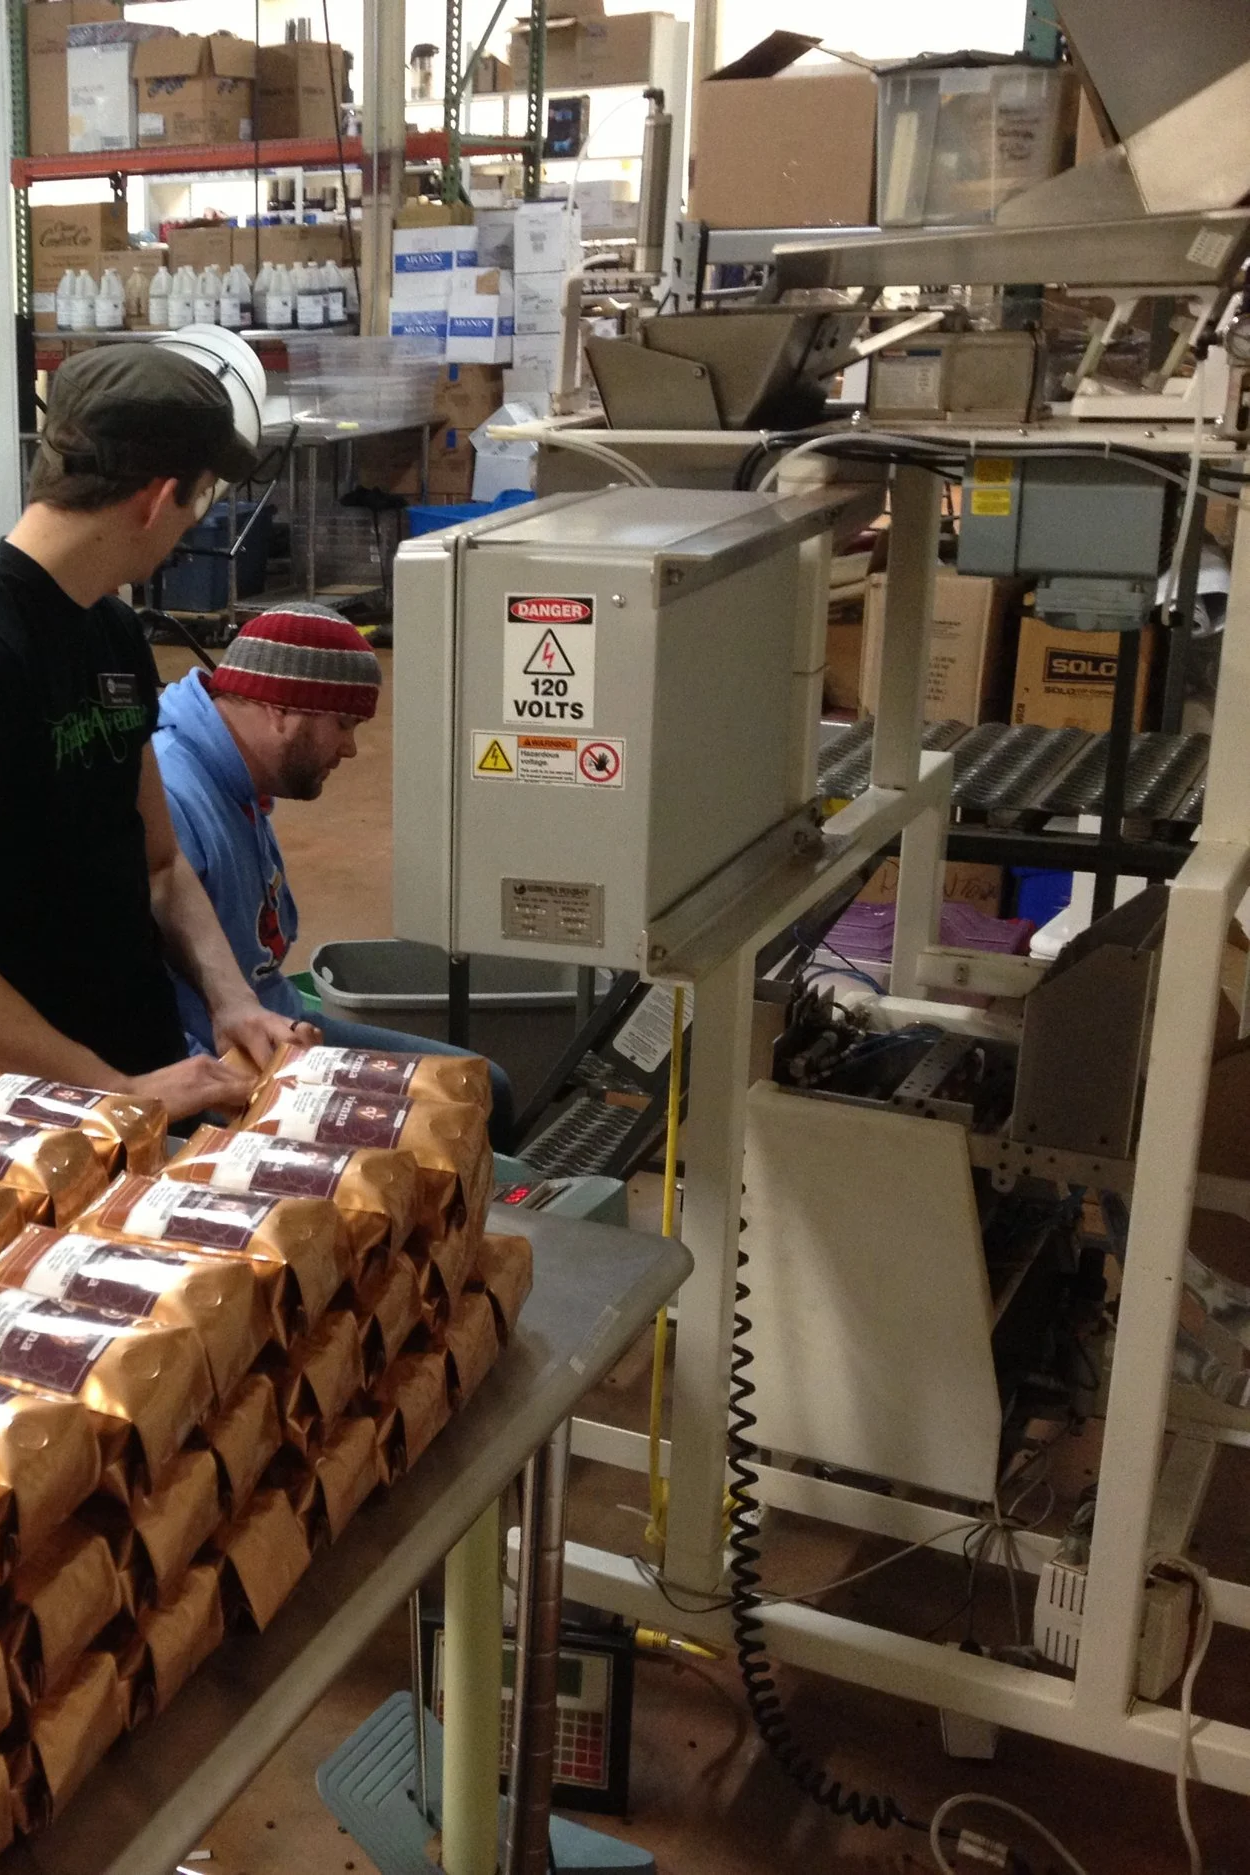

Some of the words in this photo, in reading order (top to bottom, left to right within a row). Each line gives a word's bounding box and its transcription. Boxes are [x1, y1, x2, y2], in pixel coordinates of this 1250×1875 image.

[405, 254, 443, 264] MONIN
[402, 325, 438, 333] MONIN
[453, 319, 489, 328] MONIN
[517, 603, 583, 618] DANGER
[1052, 657, 1117, 677] SOLO
[530, 678, 569, 697] 120
[513, 700, 585, 720] VOLTS
[531, 739, 572, 748] WARNING
[335, 1095, 358, 1127] vienna
